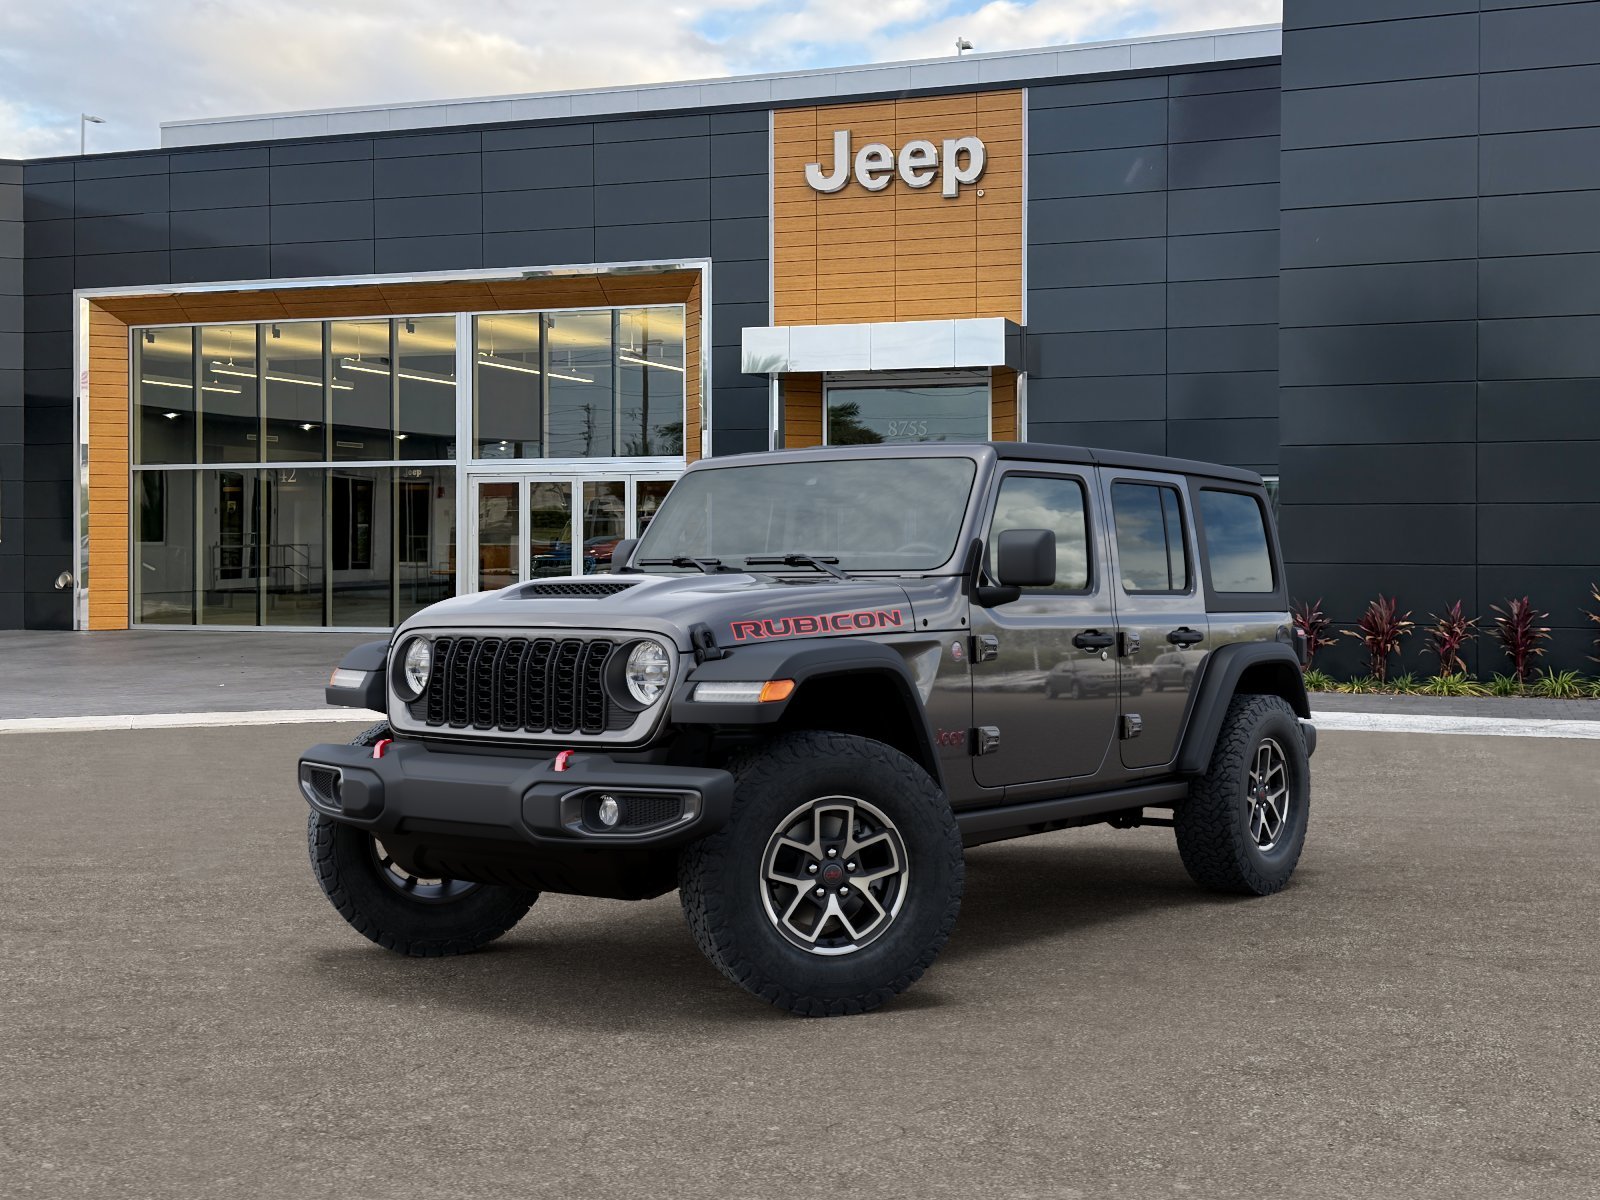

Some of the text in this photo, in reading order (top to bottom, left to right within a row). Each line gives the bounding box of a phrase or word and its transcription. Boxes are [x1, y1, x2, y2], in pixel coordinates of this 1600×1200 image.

[804, 129, 987, 198] Jeep
[887, 420, 928, 437] 8755
[730, 609, 904, 641] RUBICON
